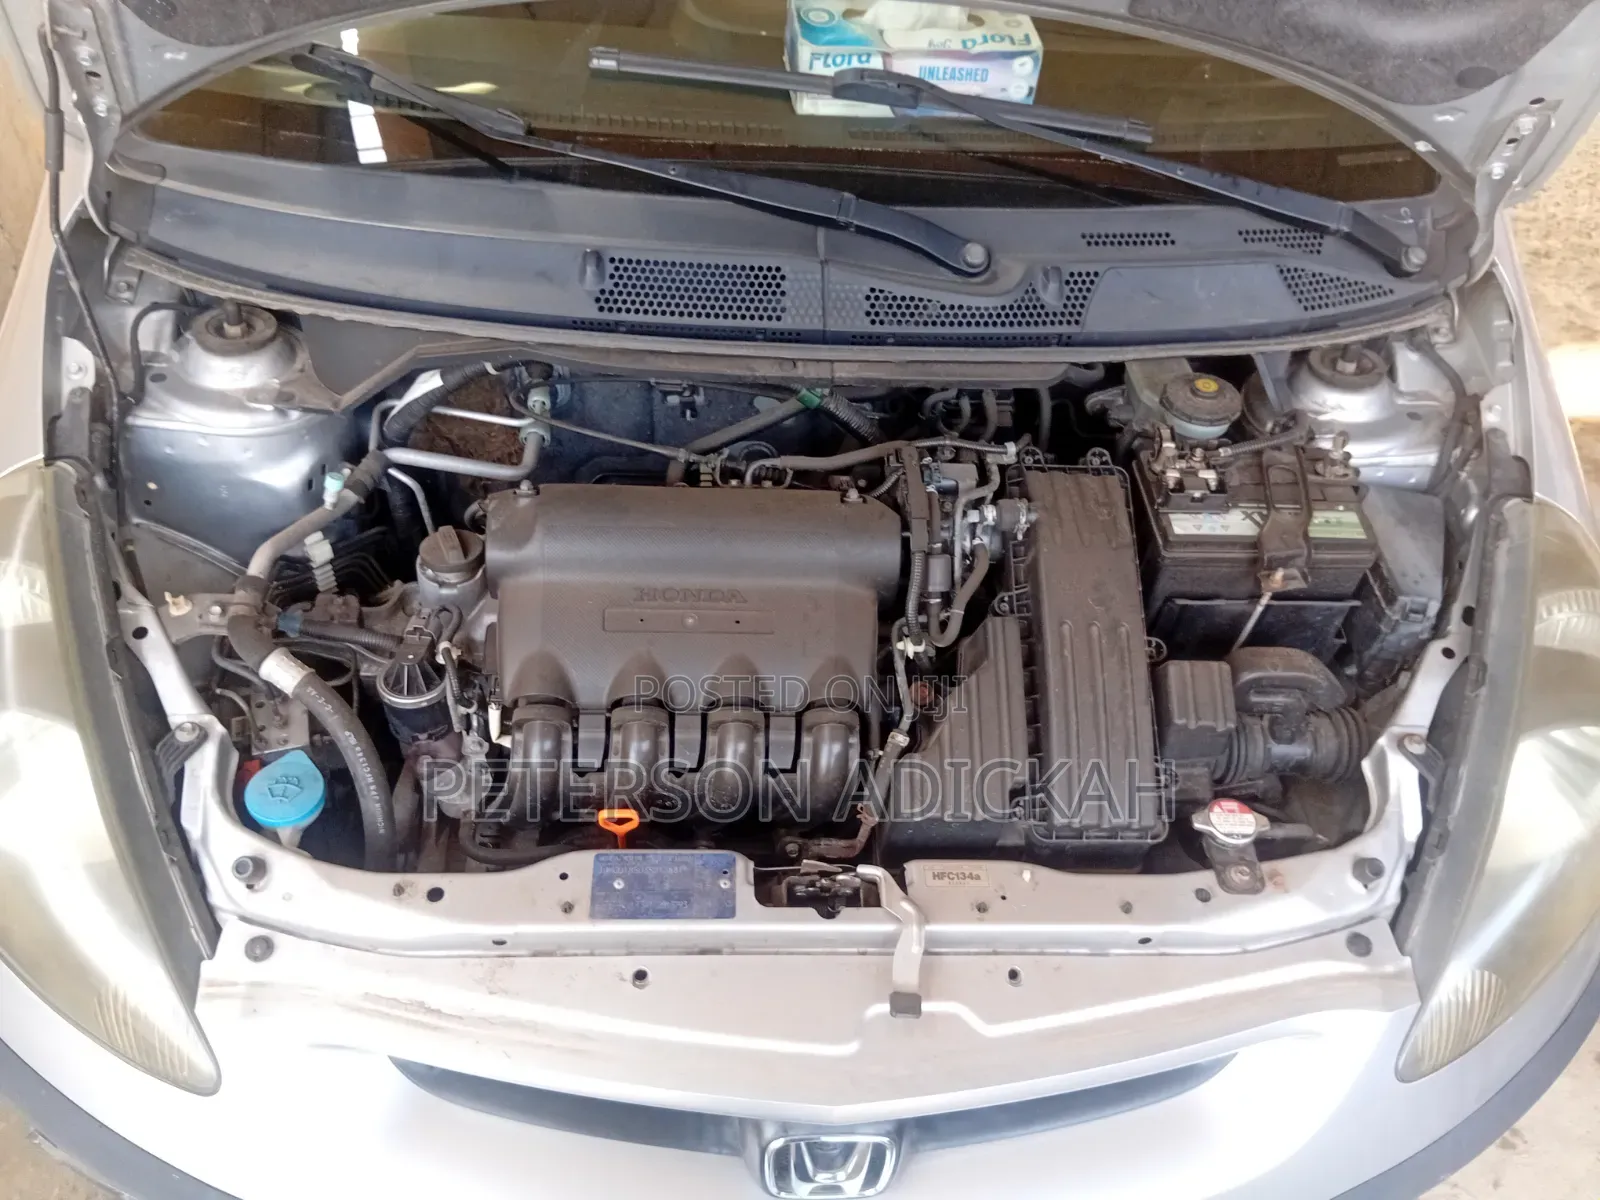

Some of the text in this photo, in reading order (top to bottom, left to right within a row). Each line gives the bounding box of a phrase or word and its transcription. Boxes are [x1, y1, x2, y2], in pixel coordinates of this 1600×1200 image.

[960, 33, 1032, 50] Flora
[809, 52, 872, 70] Flora
[919, 66, 989, 83] UNLEASHED
[633, 587, 748, 604] HONDA
[931, 871, 982, 881] HFC134a
